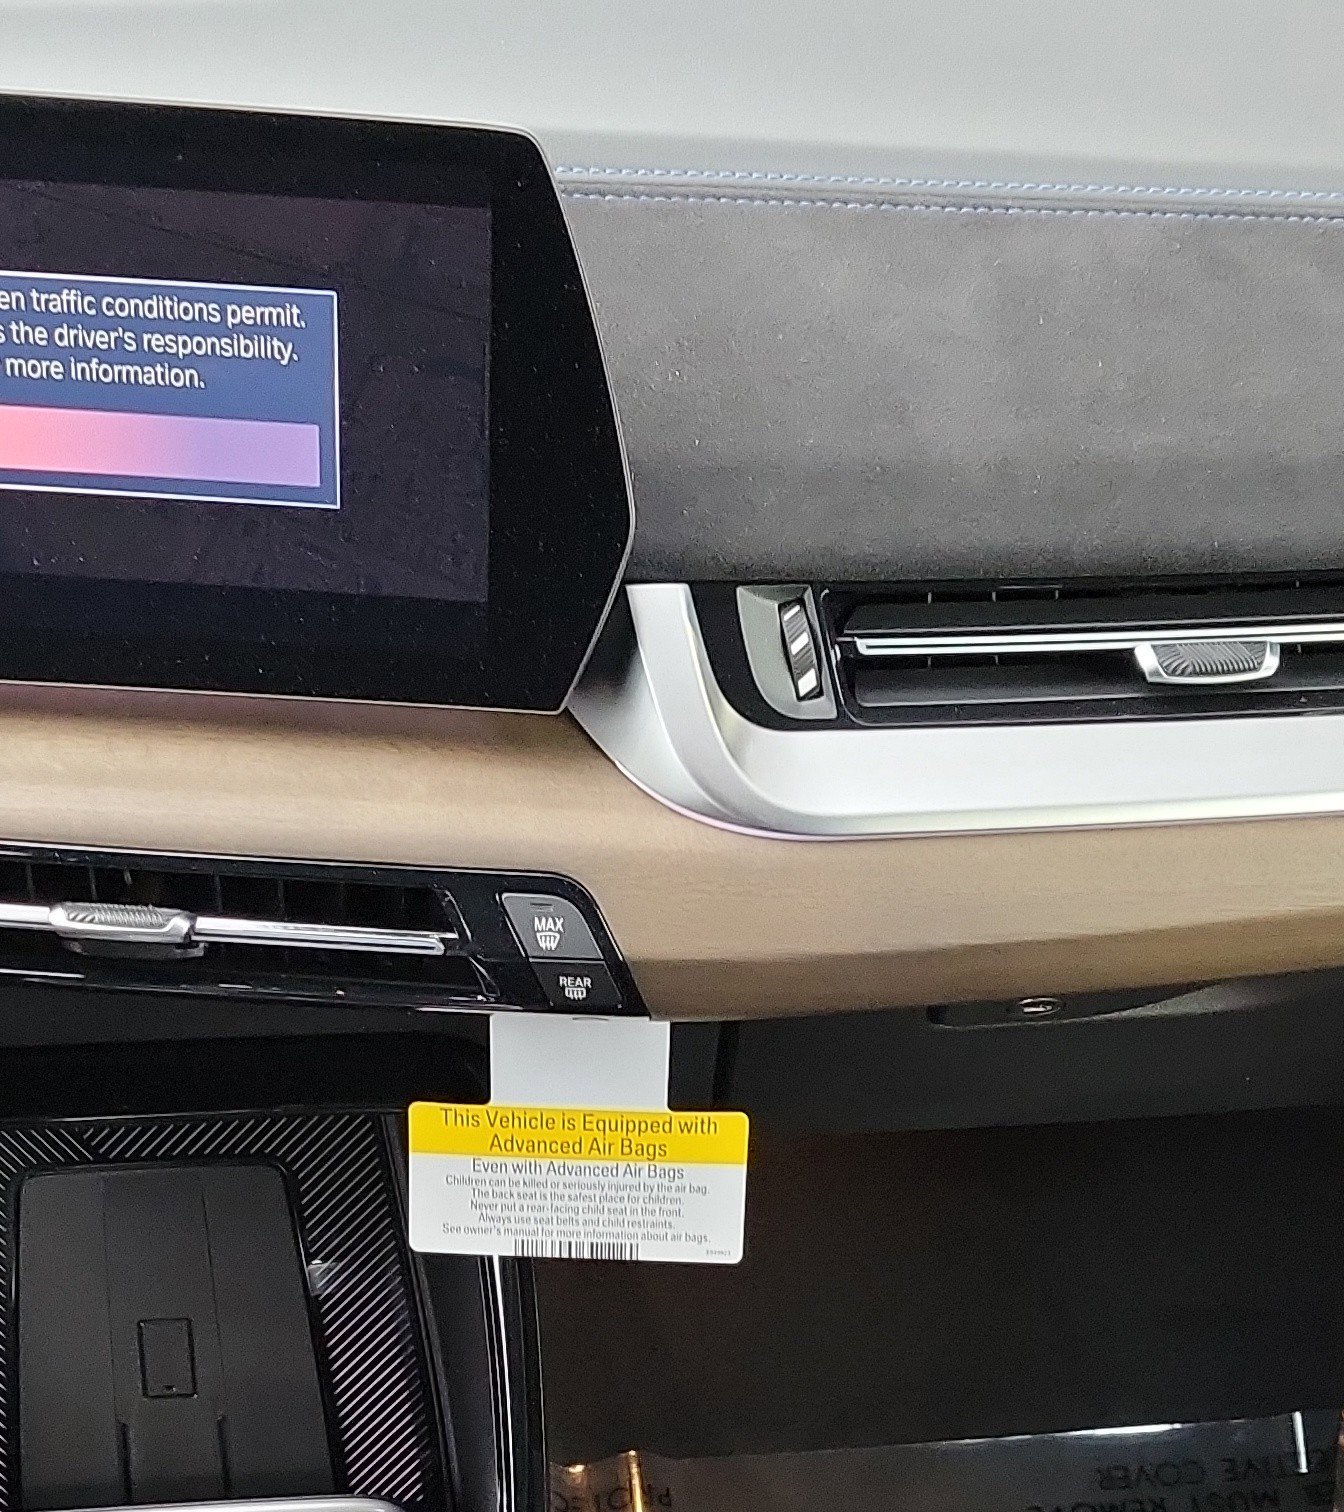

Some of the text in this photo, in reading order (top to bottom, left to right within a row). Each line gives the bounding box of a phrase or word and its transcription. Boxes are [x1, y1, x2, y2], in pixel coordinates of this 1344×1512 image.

[30, 288, 97, 316] traffic
[102, 295, 221, 323] conditions
[227, 302, 307, 330] permit.
[9, 320, 48, 347] the
[54, 323, 137, 352] driver's
[143, 330, 299, 366] responsibility.
[5, 356, 64, 380] more
[70, 356, 206, 389] information.
[534, 915, 564, 933] MAX
[559, 975, 592, 989] REAR
[440, 1108, 718, 1137] This Vehicle is Equipped with
[489, 1133, 668, 1161] Advanced Air Bags
[472, 1157, 685, 1182] Even with Advanced Air Bags
[446, 1175, 710, 1196] Children can be killed or seriously injured by the air bag.
[472, 1187, 684, 1206] The back seat is the safest place for children.
[470, 1200, 684, 1218] Never put a rear-facing child seat in the front.
[479, 1212, 676, 1230] Always use seat belts and child restraints.
[442, 1223, 711, 1245] See owner's manual for more information about air bags.
[1095, 1458, 1207, 1491] COVER
